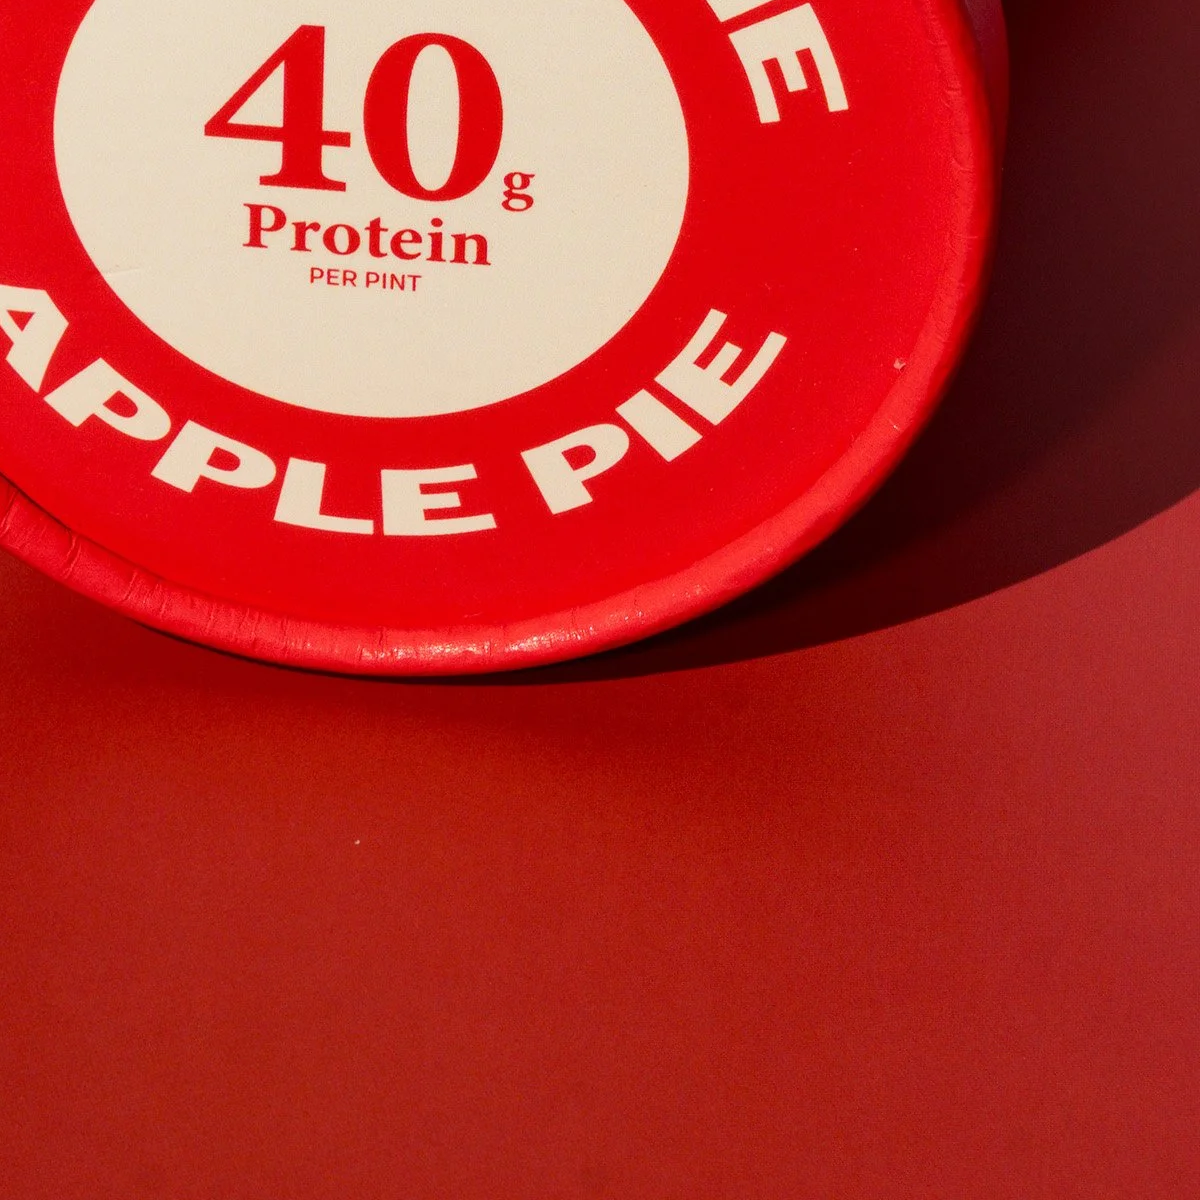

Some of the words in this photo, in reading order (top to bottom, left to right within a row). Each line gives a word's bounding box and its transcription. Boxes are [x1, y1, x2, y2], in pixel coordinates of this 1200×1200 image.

[242, 202, 492, 267] Protein
[309, 267, 357, 288] PER
[365, 271, 423, 292] PINT
[519, 307, 788, 516] PIE
